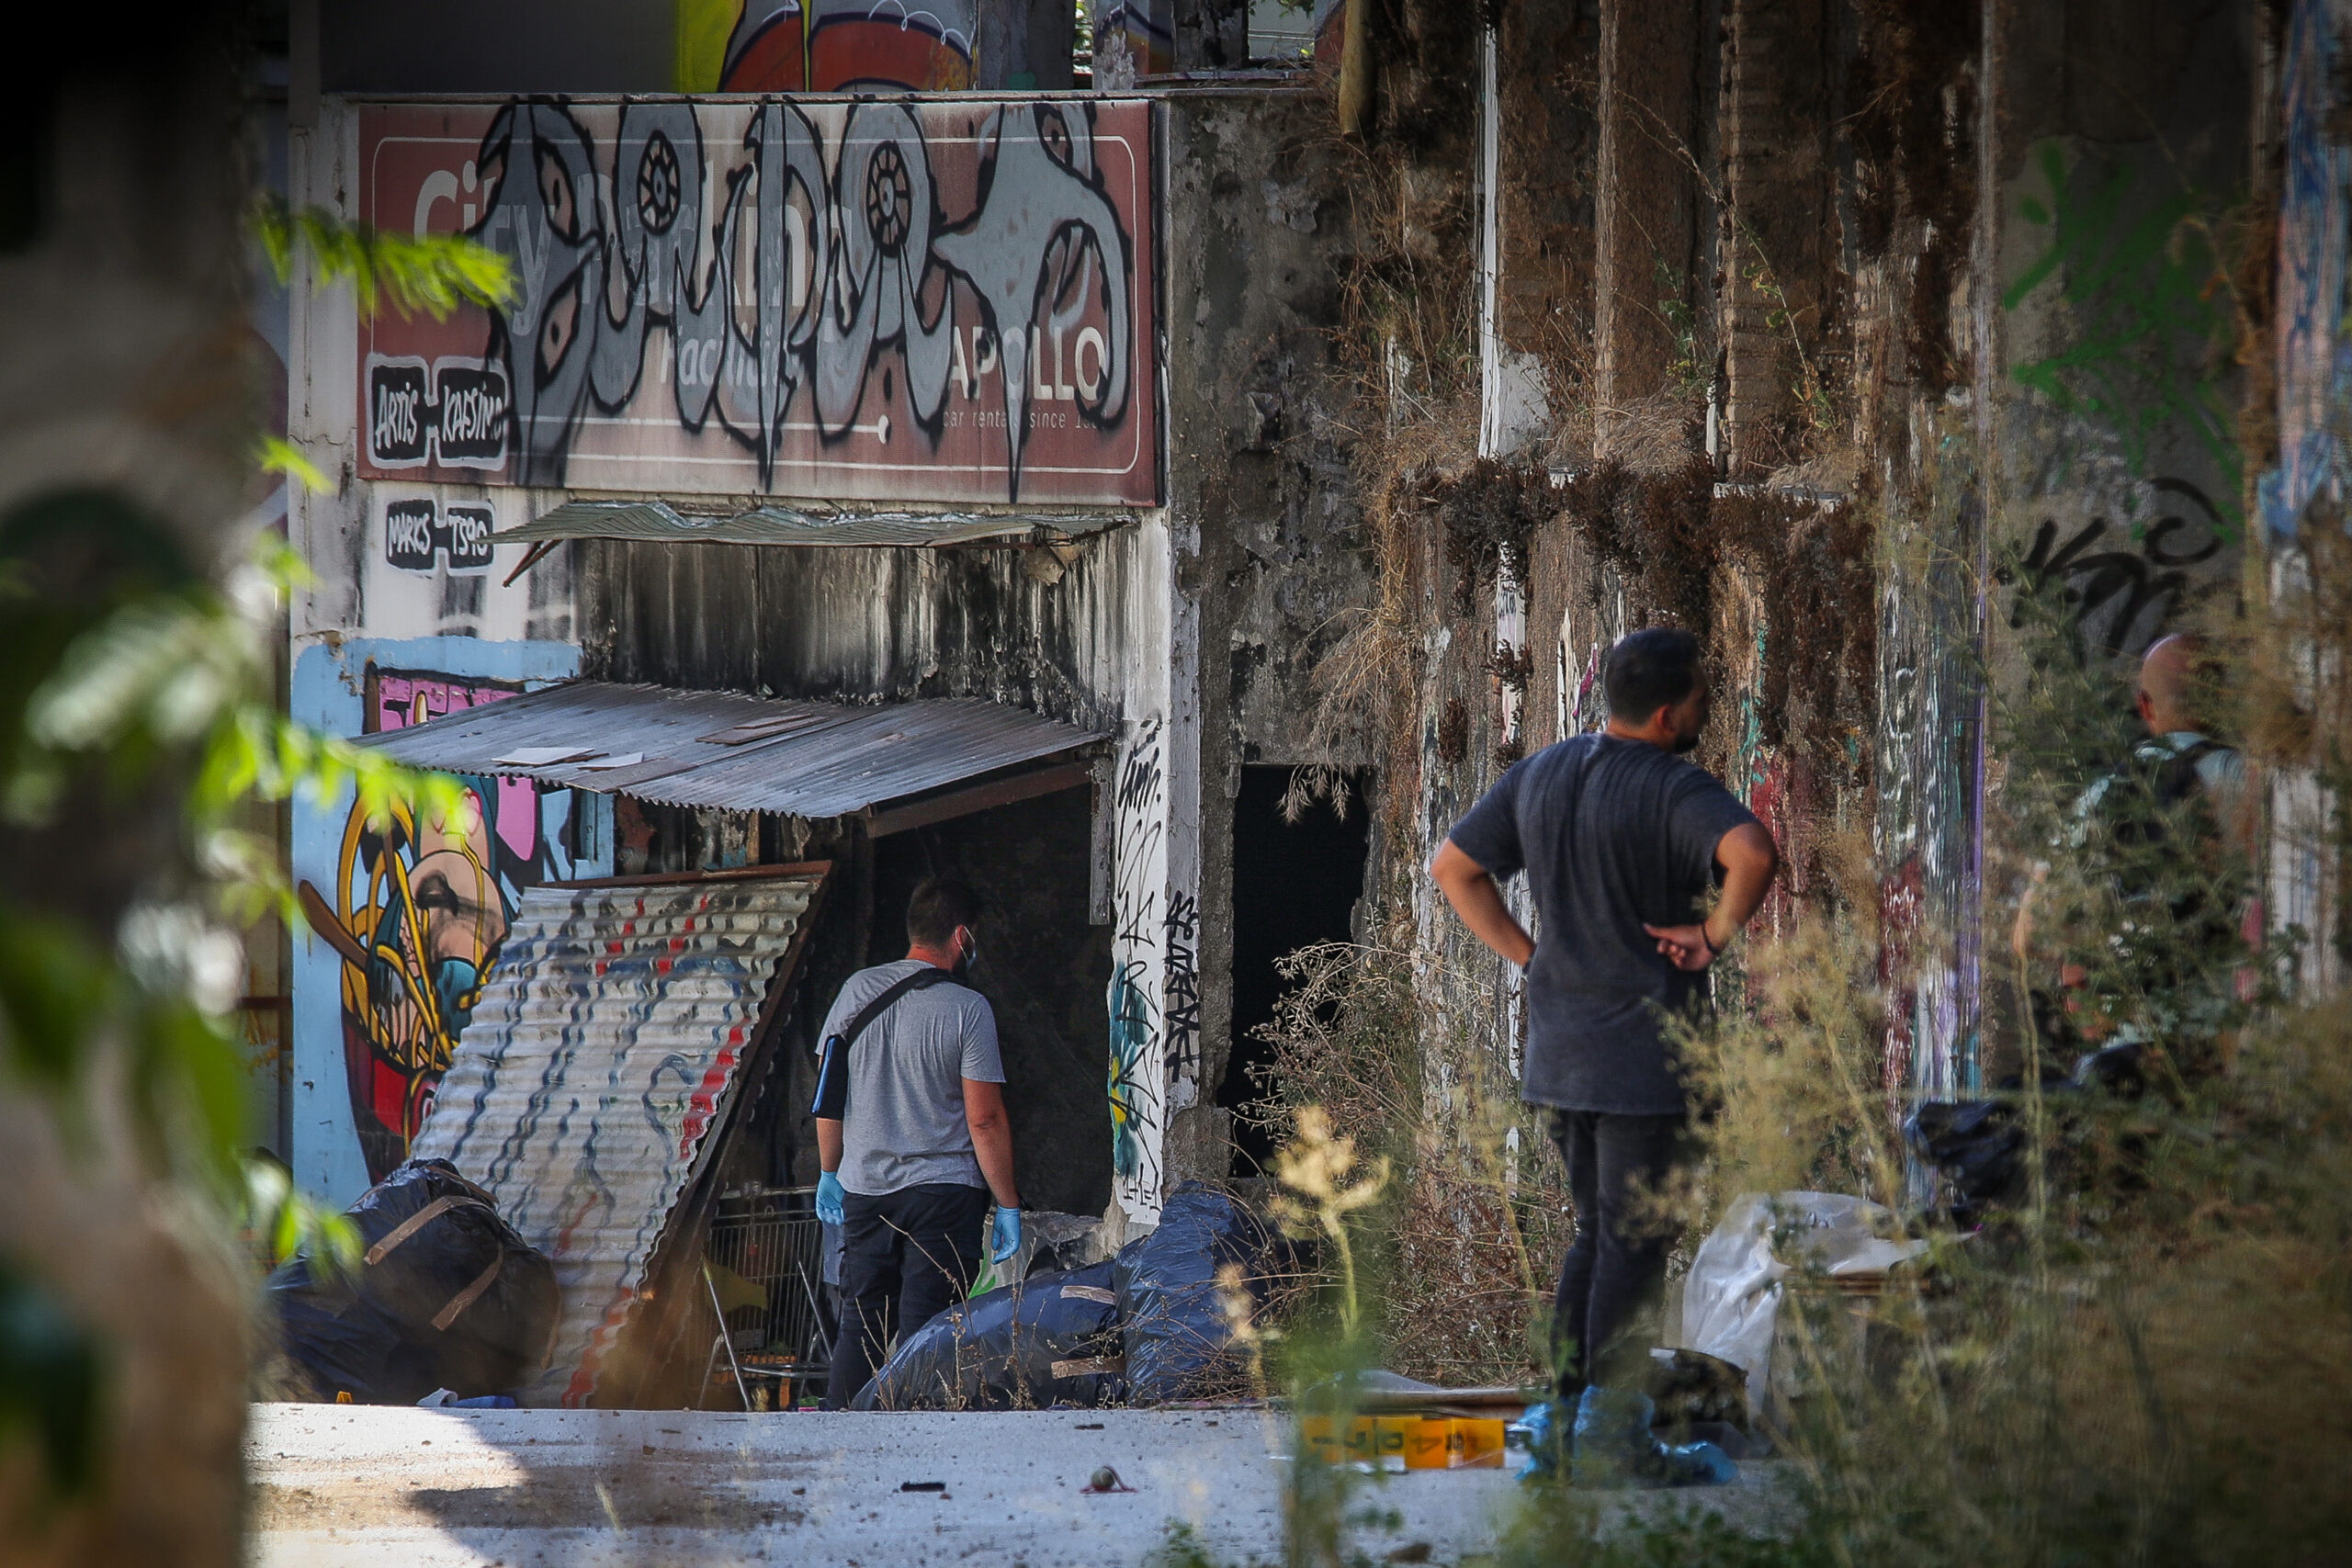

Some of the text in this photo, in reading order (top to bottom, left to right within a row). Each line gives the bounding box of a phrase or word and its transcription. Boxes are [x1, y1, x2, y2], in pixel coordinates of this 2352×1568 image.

[950, 325, 1108, 401] APOLLO
[943, 411, 965, 428] car
[972, 409, 1007, 428] renta
[1029, 406, 1066, 428] since
